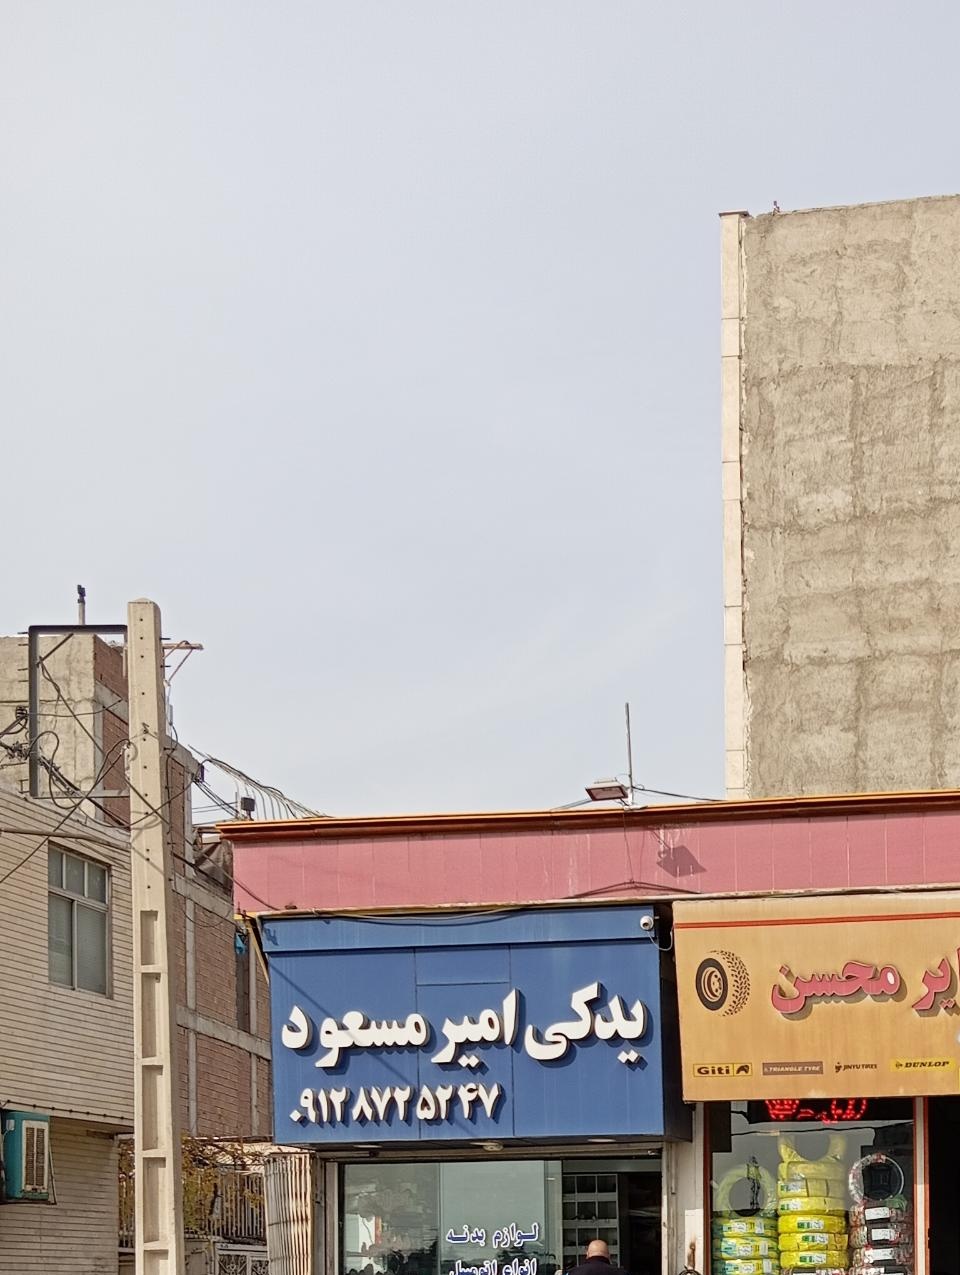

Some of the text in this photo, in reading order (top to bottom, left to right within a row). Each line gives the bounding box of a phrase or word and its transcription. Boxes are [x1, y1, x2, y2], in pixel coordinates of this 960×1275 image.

[770, 960, 900, 1014] محسن
[281, 981, 648, 1068] یدکی امیر مسعود
[697, 1065, 730, 1075] Giti
[446, 1222, 539, 1248] لوازم بدنه
